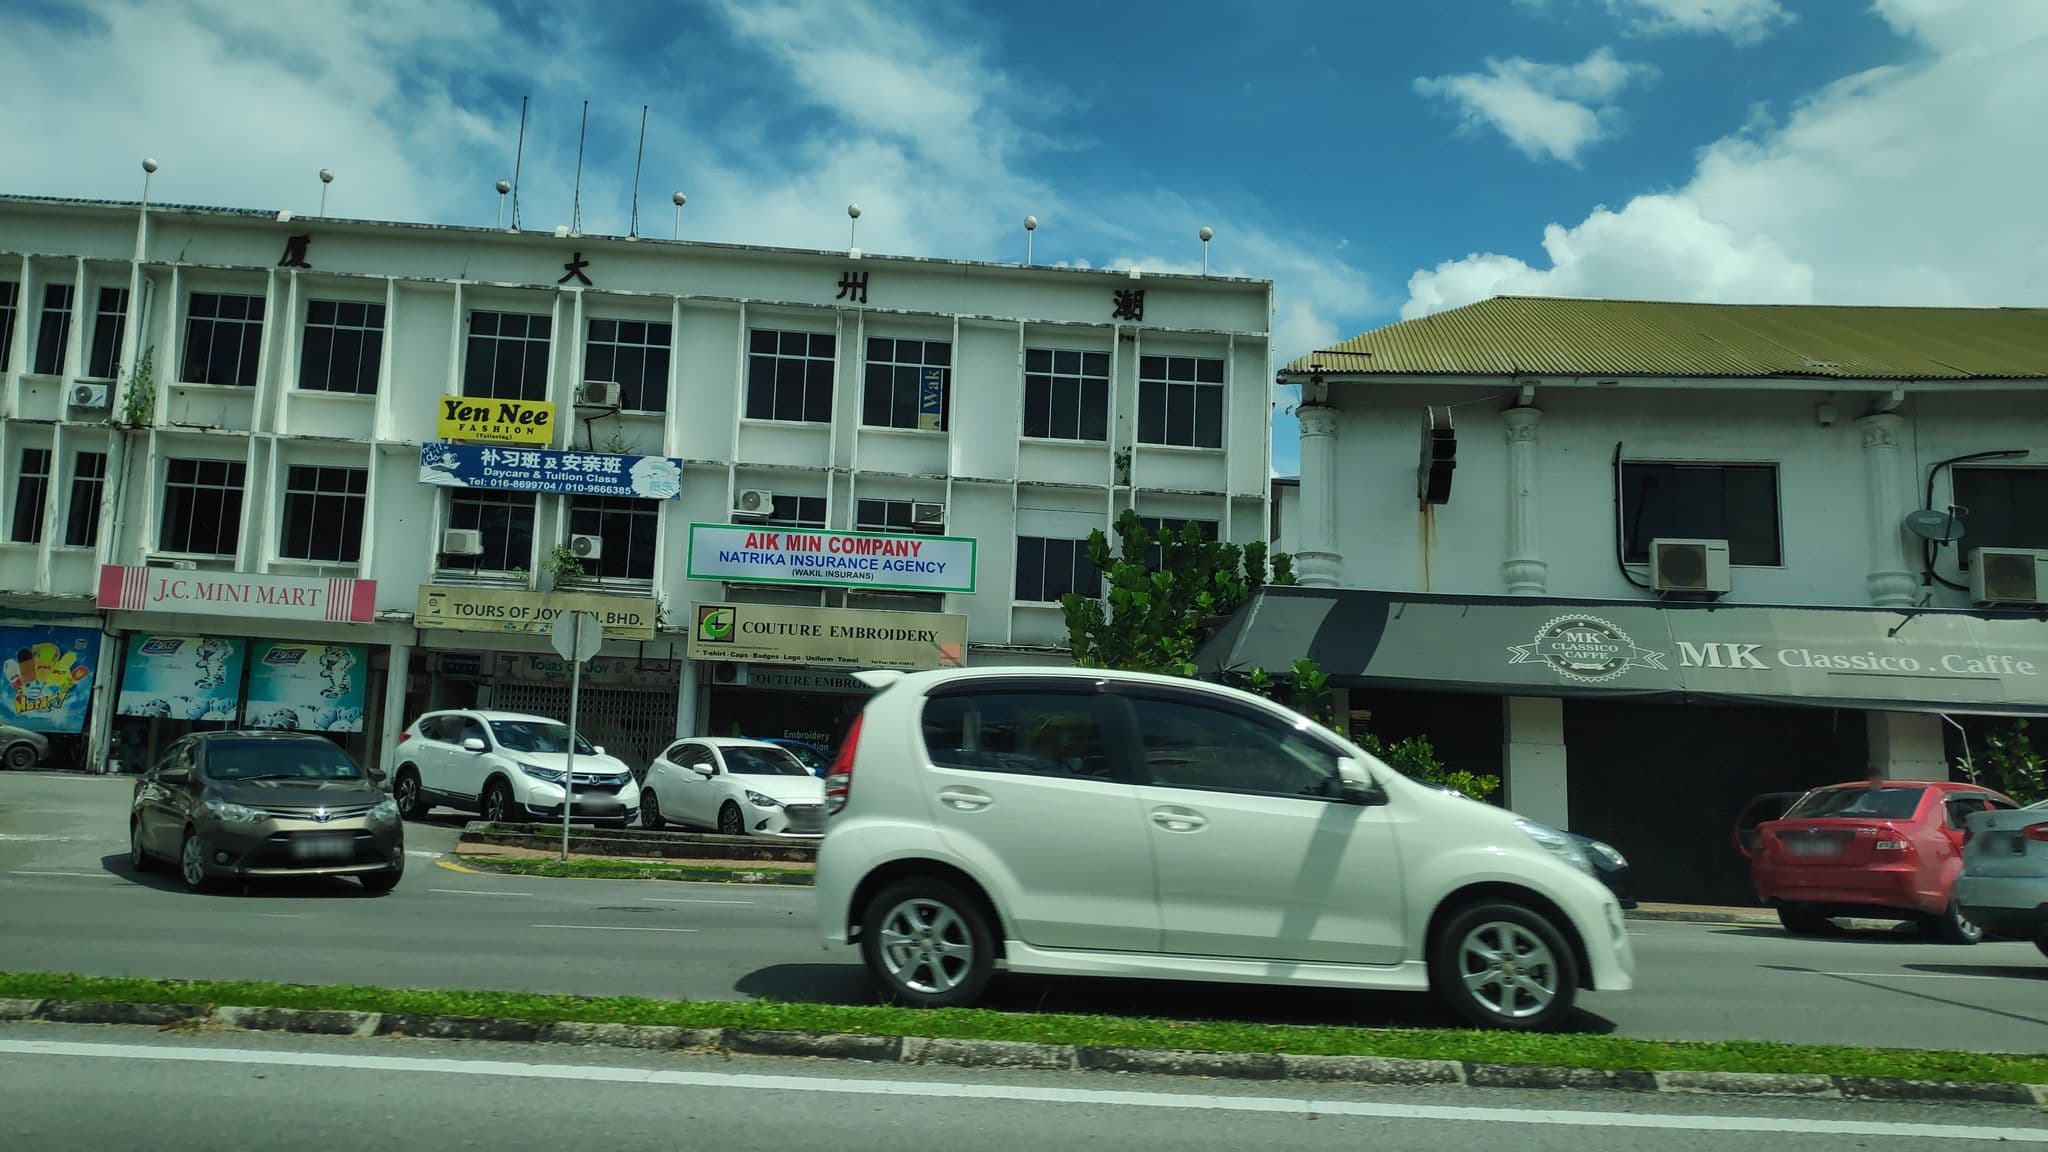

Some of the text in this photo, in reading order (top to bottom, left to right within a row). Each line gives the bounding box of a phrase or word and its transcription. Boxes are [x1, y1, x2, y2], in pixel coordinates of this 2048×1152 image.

[558, 252, 593, 286] 大
[836, 271, 869, 304] 州
[444, 400, 549, 426] Yen Nee
[458, 423, 535, 435] FASHION
[483, 467, 618, 484] Daycare & Tuition Class
[468, 477, 488, 487] Tel:
[490, 479, 557, 491] 016-8699704
[565, 483, 632, 496] 010-9666385
[744, 532, 923, 558] AIK MIN COMPANY
[719, 551, 946, 575] NATRIKA INSURANCE AGENCY
[791, 568, 874, 582] (WAKIL INSURANS)
[153, 578, 322, 607] J.C. MINI MART
[453, 603, 505, 618] TOURS
[509, 606, 531, 619] OF
[533, 607, 563, 620] JOY
[606, 612, 644, 626] BHD.
[742, 621, 938, 643] COUTURE EMBROIDERY
[1566, 632, 1601, 644] MK
[1551, 642, 1619, 653] CLASSICO
[1564, 650, 1609, 660] CAFFE
[752, 653, 779, 661] Badges
[805, 655, 834, 663] Uniform
[1674, 640, 2038, 677] MK Classico Caffe
[783, 729, 831, 742] Embroidery
